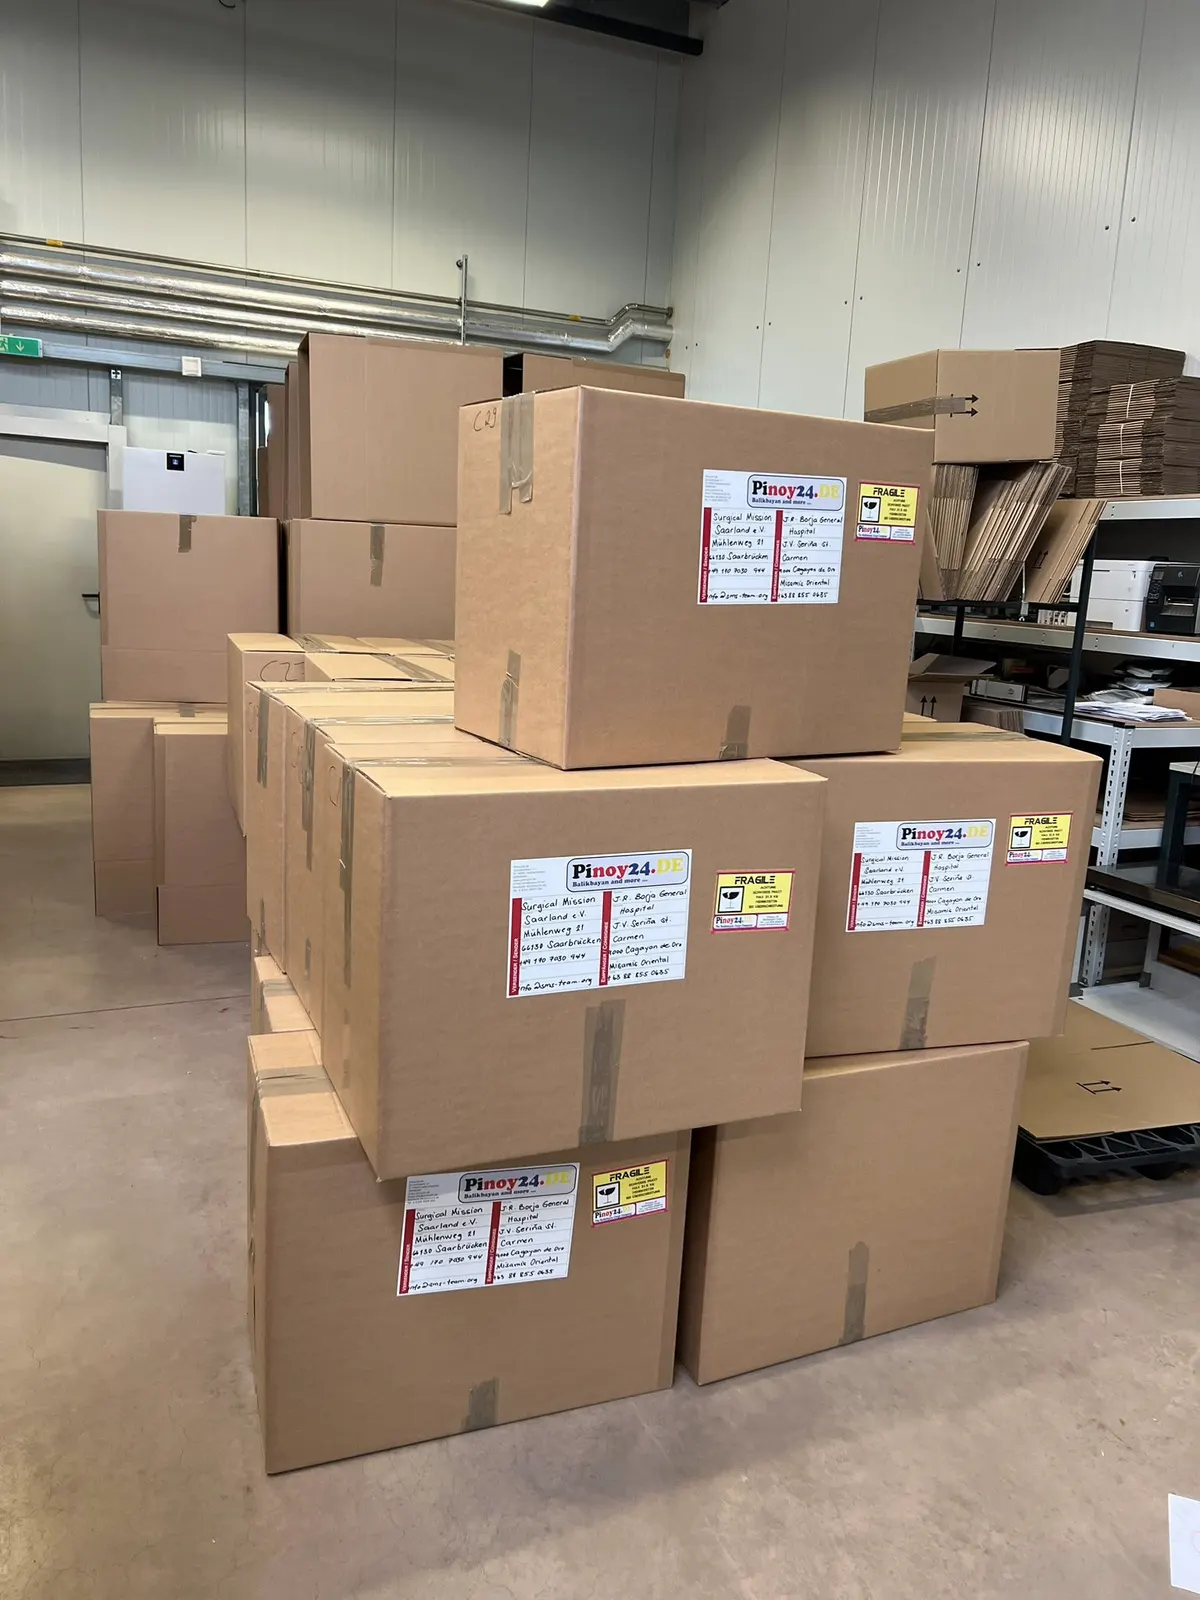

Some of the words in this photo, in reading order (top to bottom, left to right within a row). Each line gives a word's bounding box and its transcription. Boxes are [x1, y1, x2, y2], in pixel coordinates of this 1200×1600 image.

[752, 480, 841, 500] Pinoy24.DE
[873, 487, 906, 498] FRAGILE
[713, 512, 742, 524] Surgical
[746, 512, 772, 522] Mission
[819, 516, 843, 524] General
[715, 525, 750, 535] Saarland
[789, 527, 816, 538] Hospital
[782, 553, 808, 562] Carmen
[901, 825, 989, 841] Pinoy24.DE
[967, 851, 989, 859] General
[572, 857, 683, 879] Pinoy24.DE
[572, 879, 610, 888] Balikbayan
[734, 875, 776, 885] FRAGILE
[659, 888, 687, 898] General
[522, 901, 558, 913] Surgical
[562, 896, 596, 906] Mission
[620, 904, 655, 917] Hospital
[524, 913, 568, 925] Saarland
[523, 926, 571, 939] Mühlenweg
[612, 933, 644, 943] Carmen
[547, 937, 602, 949] Saarbrücken
[625, 944, 658, 956] Cagayan
[640, 955, 669, 966] Oriental
[609, 1166, 650, 1182] FRAGILE
[465, 1171, 571, 1192] Pinoy24.DE
[464, 1190, 500, 1199] Balikbayan
[519, 1201, 540, 1212] Borja
[542, 1199, 569, 1208] General
[415, 1210, 447, 1221] Surgical
[451, 1206, 483, 1216] Mission
[507, 1213, 539, 1224] Hospital
[417, 1219, 459, 1232] Saarland
[414, 1233, 462, 1245] Mühlenweg
[500, 1237, 534, 1247] Carmen
[435, 1241, 488, 1254] Saarbrücken
[510, 1248, 542, 1258] Cagayan
[529, 1256, 559, 1266] Oriental
